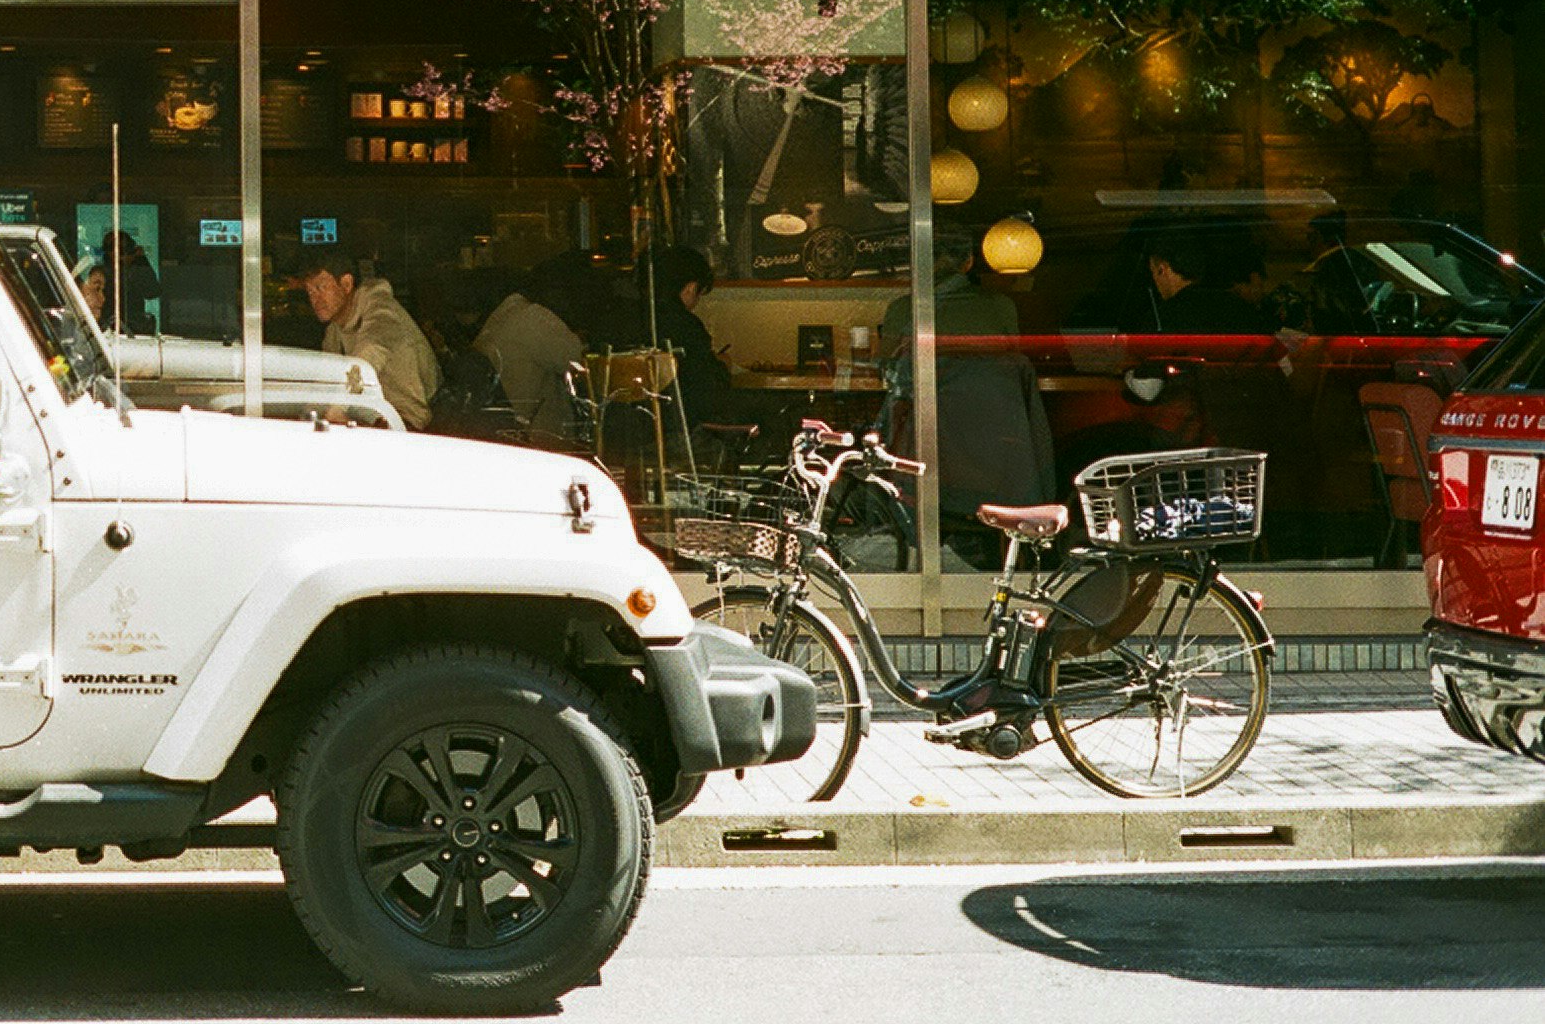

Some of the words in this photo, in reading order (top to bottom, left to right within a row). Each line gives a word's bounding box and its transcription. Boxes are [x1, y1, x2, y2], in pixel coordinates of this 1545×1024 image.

[86, 632, 161, 640] SAHARA
[62, 674, 178, 685] WRANGLER
[79, 688, 165, 696] UNLIMITED
